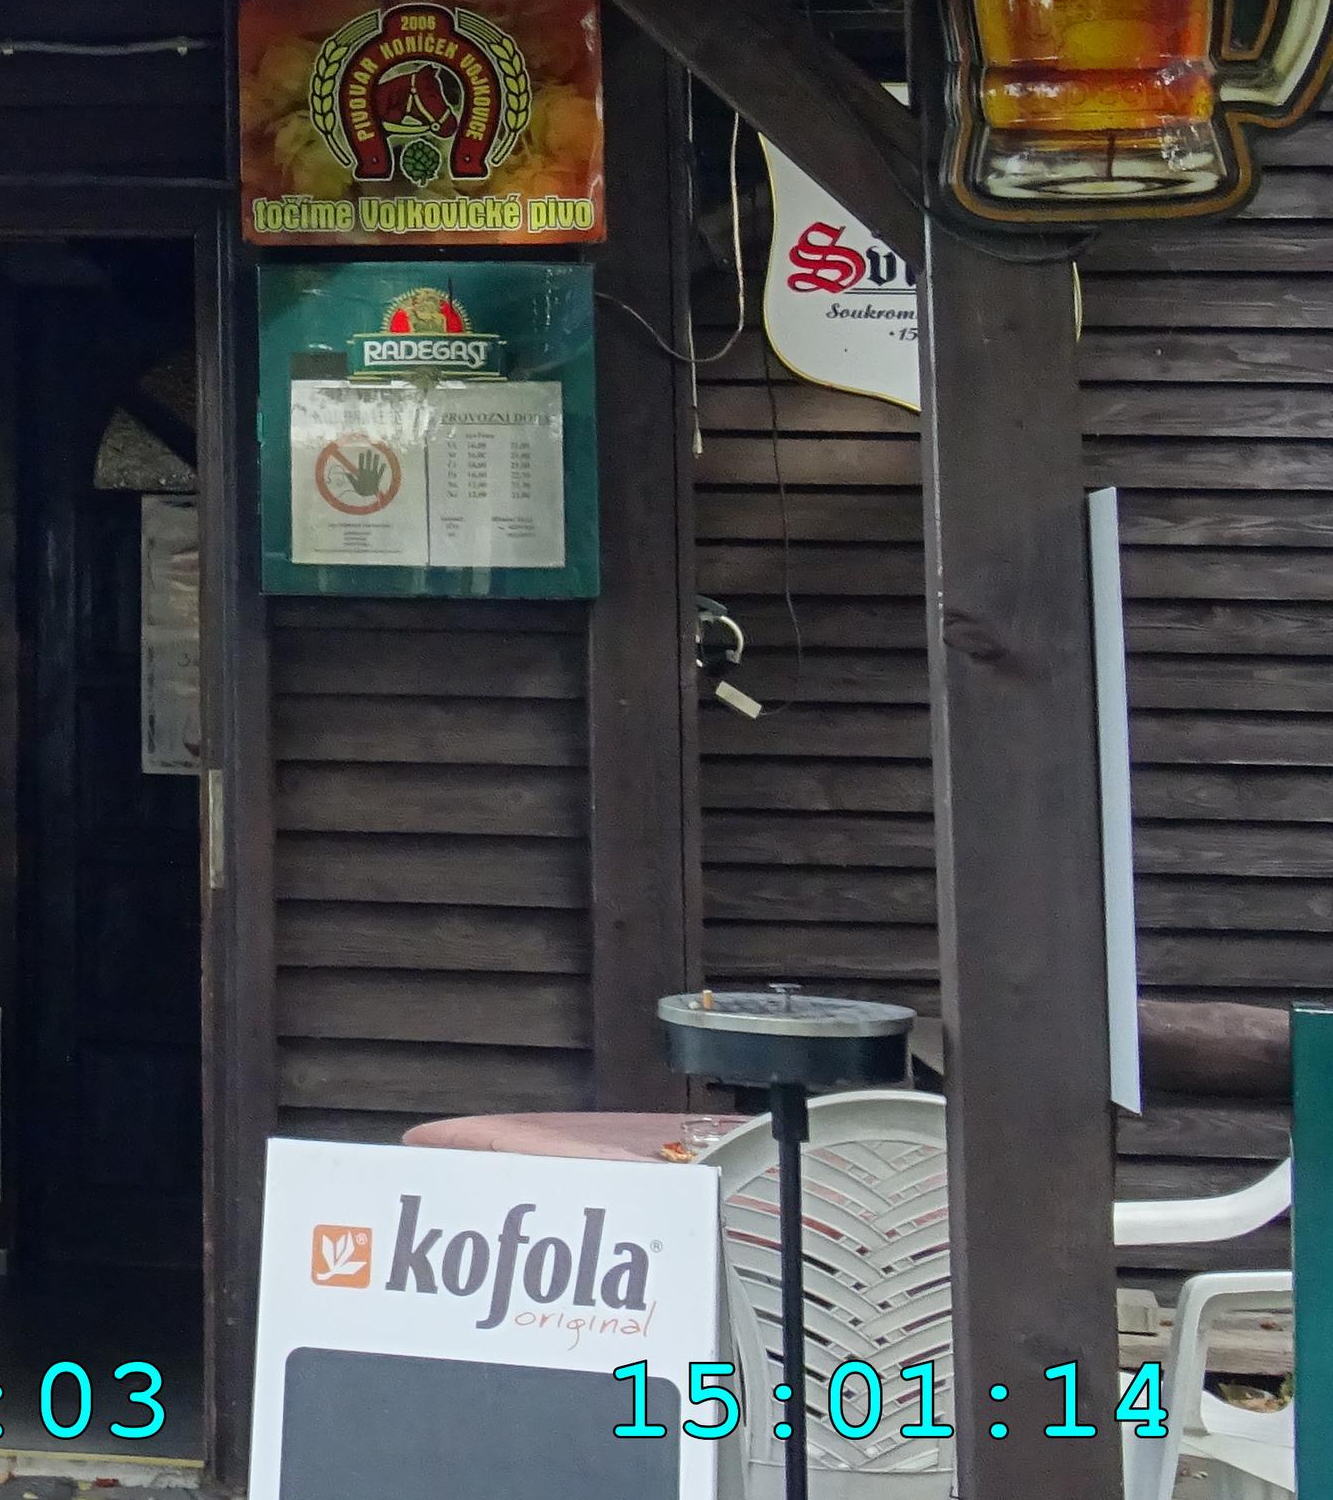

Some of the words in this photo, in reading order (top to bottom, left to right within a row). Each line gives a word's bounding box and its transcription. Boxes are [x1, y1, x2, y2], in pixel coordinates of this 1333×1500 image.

[401, 15, 436, 31] 2006
[349, 56, 379, 142] PIVOVAR
[460, 53, 492, 141] VOJKOVICE
[253, 194, 355, 234] točíme
[360, 193, 523, 234] Vojkovické
[528, 196, 595, 234] pivo
[826, 303, 917, 320] Soukrom
[364, 340, 489, 369] RADEGAST
[385, 1194, 650, 1329] kofola
[514, 1301, 657, 1351] original
